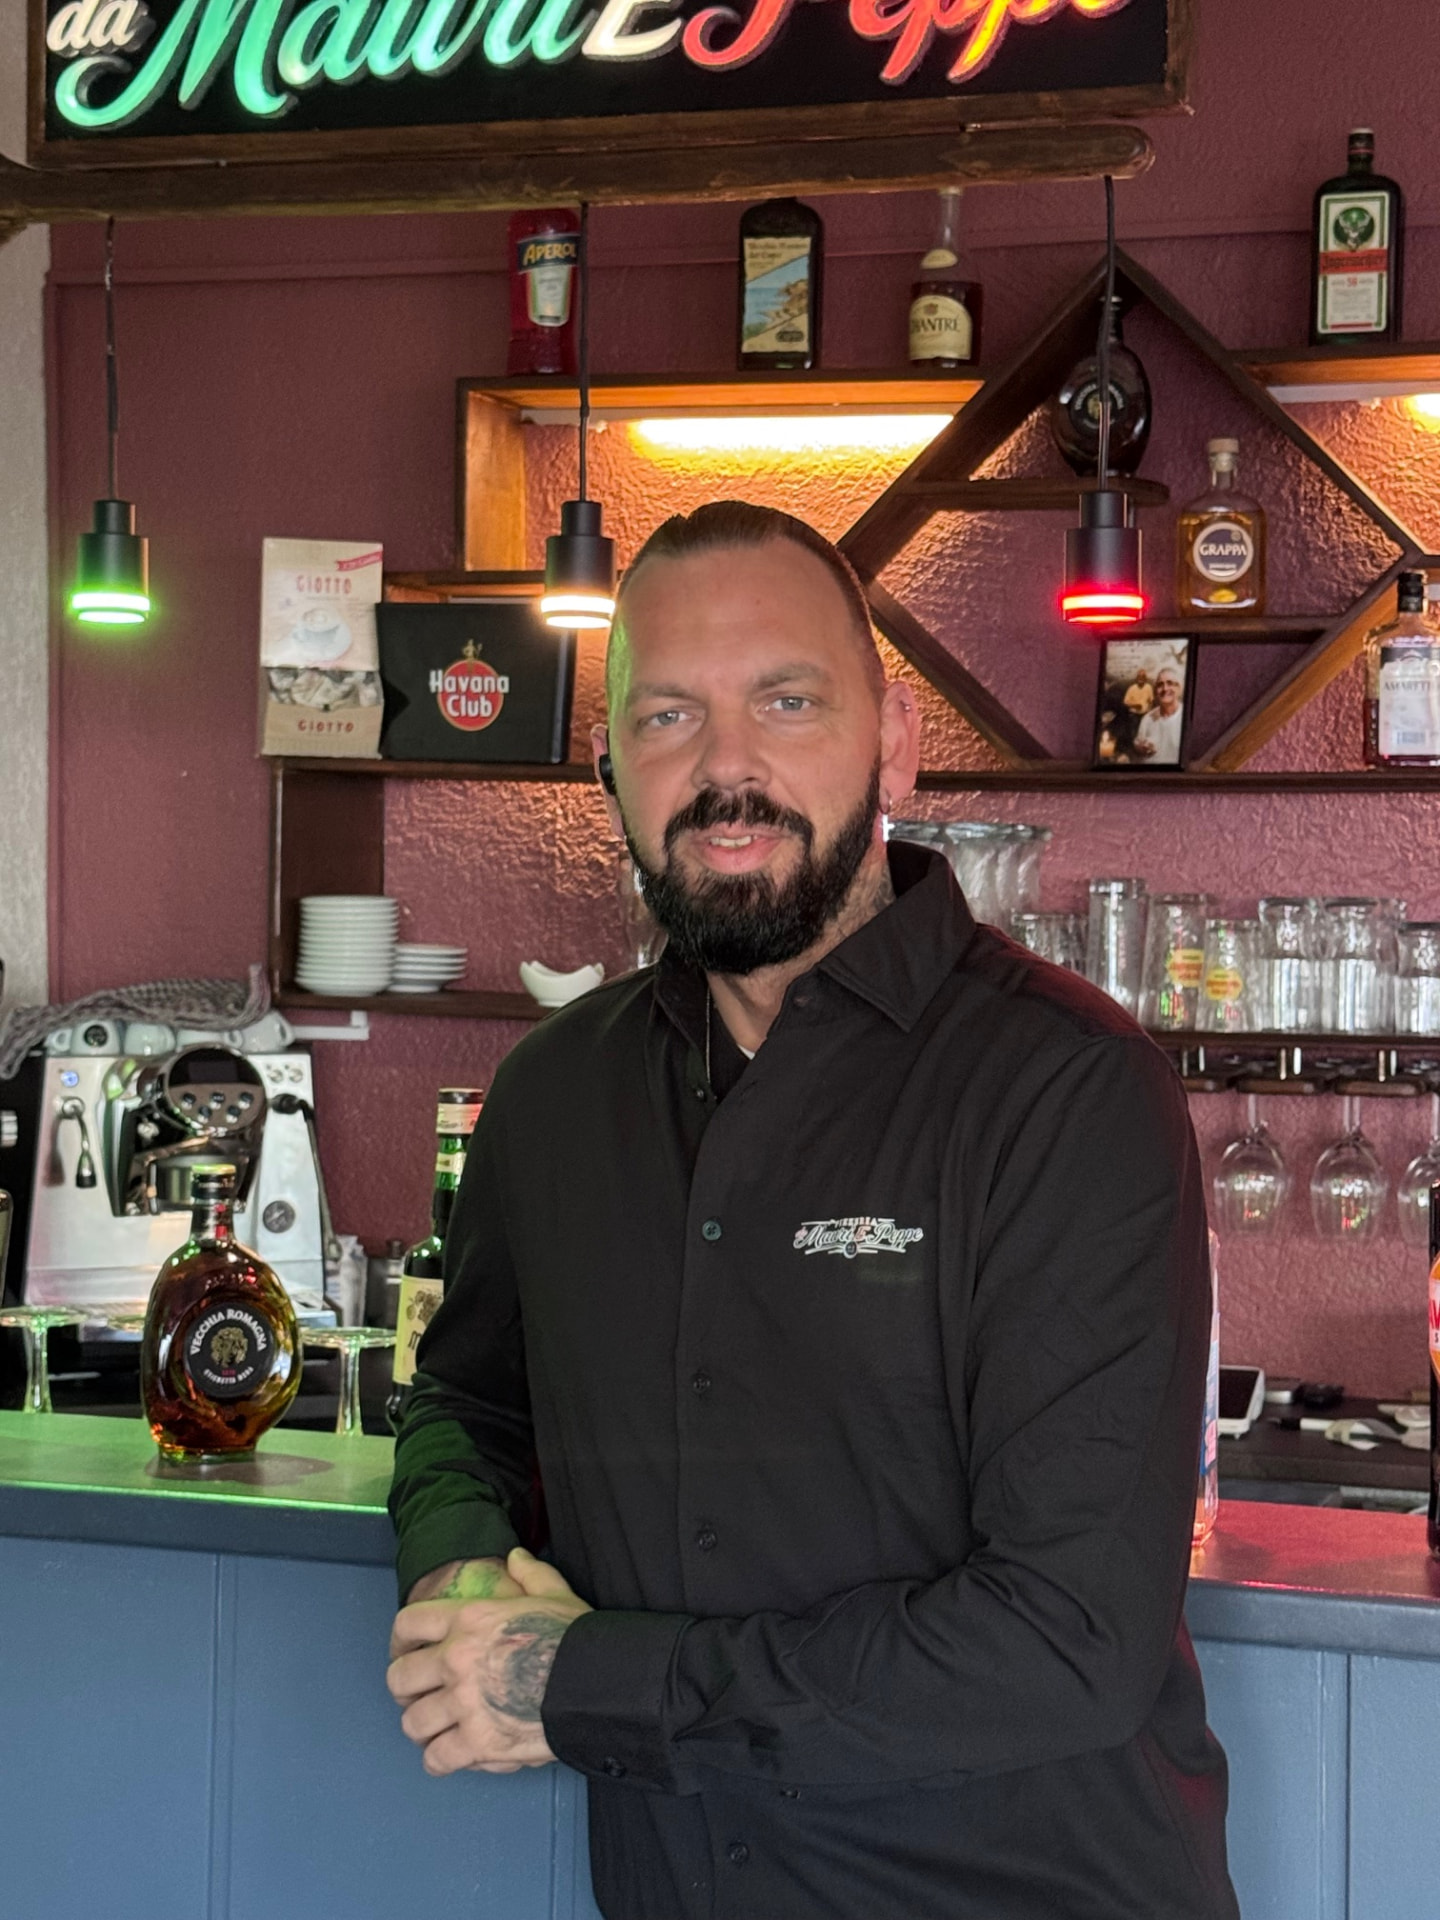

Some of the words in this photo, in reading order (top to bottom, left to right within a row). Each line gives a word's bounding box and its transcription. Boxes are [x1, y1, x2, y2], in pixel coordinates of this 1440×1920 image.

[1200, 543, 1247, 556] GRAPPA
[429, 669, 510, 693] Havana
[446, 695, 493, 718] Club
[298, 719, 354, 734] GIOTTO
[190, 1312, 225, 1355] VECCHIA
[226, 1308, 266, 1352] ROMAGNA
